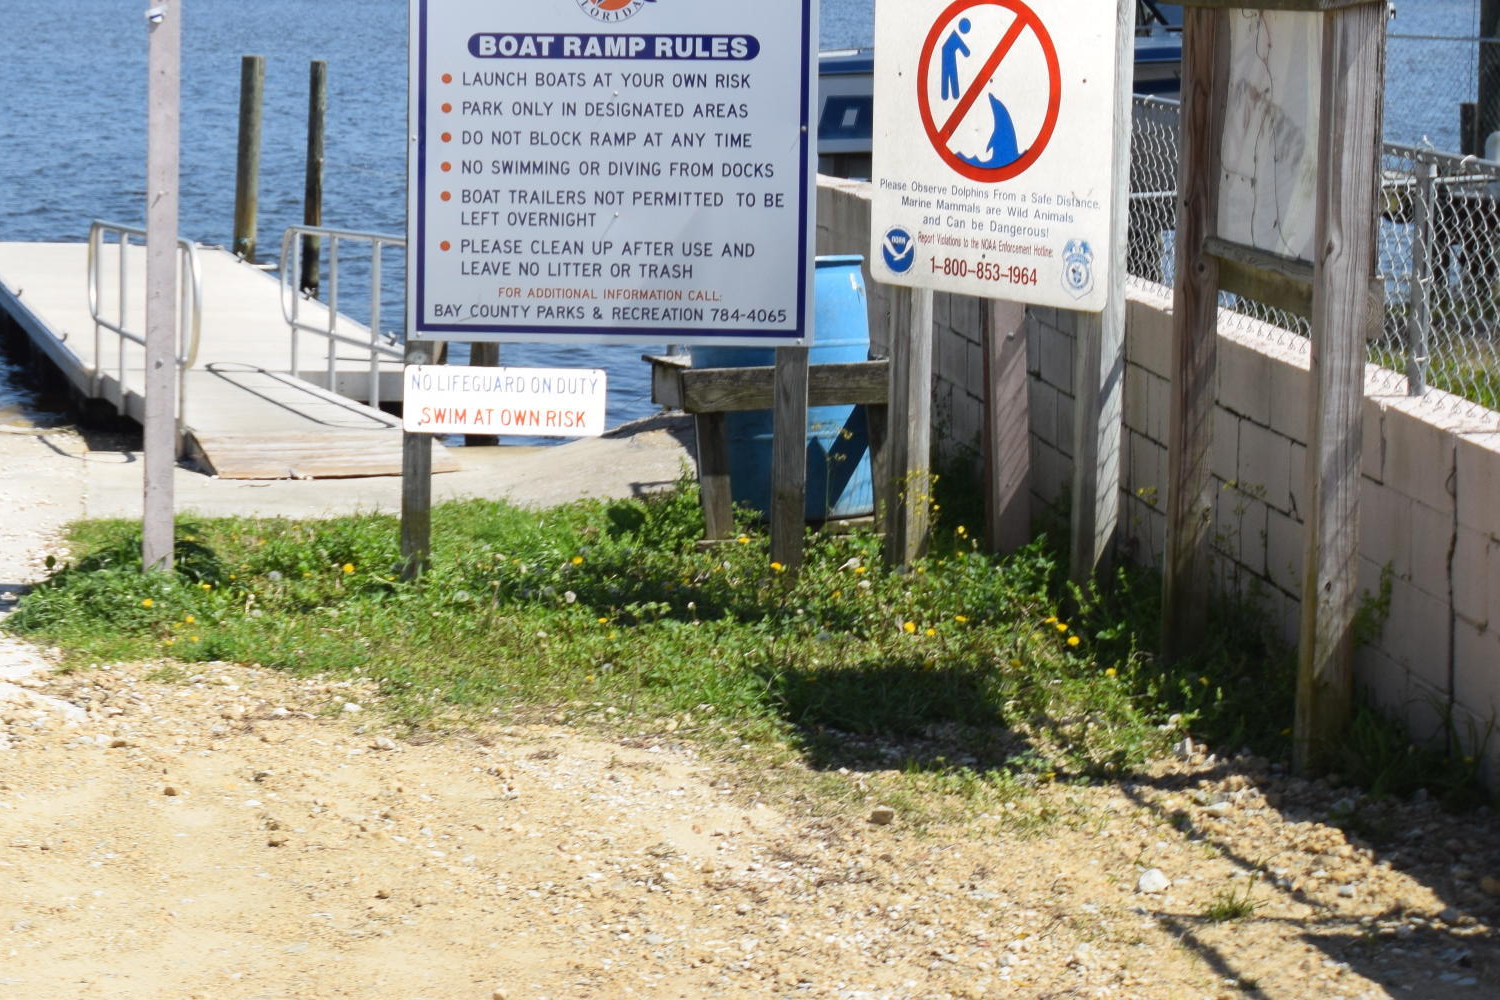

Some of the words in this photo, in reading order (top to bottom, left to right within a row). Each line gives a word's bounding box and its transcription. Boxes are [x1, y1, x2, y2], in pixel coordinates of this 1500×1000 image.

[478, 36, 555, 57] BOAT
[563, 37, 647, 58] RAMP
[654, 37, 748, 58] RULES
[462, 72, 527, 87] LAUNCH
[535, 73, 586, 88] BOATS
[593, 73, 612, 88] AT
[621, 74, 664, 88] YOUR
[672, 74, 707, 88] OWN
[715, 74, 751, 88] RISK
[462, 102, 502, 116] PARK
[512, 102, 553, 117] ONLY
[562, 103, 576, 117] IN
[585, 103, 684, 118] DESIGNATED
[693, 104, 748, 118] AREAS
[462, 131, 483, 145] DO
[491, 131, 521, 146] NOT
[530, 132, 581, 146] BLOCK
[590, 132, 637, 147] RAMP
[643, 133, 662, 147] AT
[671, 133, 706, 147] ANY
[715, 133, 752, 148] TIME
[461, 160, 483, 174] NO
[491, 160, 570, 175] SWIMMING
[579, 161, 600, 175] OR
[608, 162, 661, 176] DIVING
[670, 162, 713, 177] FROM
[722, 163, 774, 177] DOCKS
[461, 190, 500, 204] BOAT
[509, 190, 586, 205] TRAILERS
[594, 191, 624, 206] NOT
[632, 192, 724, 207] PERMITTED
[736, 193, 755, 207] TO
[764, 193, 785, 208] BE
[880, 178, 907, 191] Please
[911, 182, 947, 195] Observe
[951, 185, 989, 200] Dolphins
[993, 189, 1016, 201] From
[1020, 193, 1026, 202] a
[1031, 192, 1052, 204] Safe
[901, 196, 932, 209] Marine
[936, 200, 981, 213] Mammals
[986, 206, 1001, 215] are
[1007, 206, 1028, 218] Wild
[1034, 209, 1074, 223] Animals
[461, 212, 498, 226] LEFT
[507, 212, 597, 228] OVERNIGHT
[923, 214, 940, 226] and
[946, 216, 966, 229] Can
[971, 219, 984, 231] be
[989, 221, 1049, 238] Dangerous!
[460, 239, 523, 255] PLEASE
[530, 240, 584, 255] CLEAN
[591, 241, 613, 256] UP
[621, 242, 674, 256] AFTER
[682, 242, 713, 257] USE
[721, 243, 755, 258] AND
[917, 231, 935, 246] Report
[937, 233, 961, 248] Violations
[963, 237, 969, 248] to
[971, 237, 979, 249] the
[981, 237, 996, 250] NOAA
[999, 240, 1032, 255] Enforcement
[461, 261, 511, 276] LEAVE
[518, 262, 539, 276] NO
[547, 262, 601, 277] LITTER
[610, 263, 630, 278] OR
[639, 263, 693, 279] TRASH
[930, 255, 1037, 286] 1-800-853-1964
[498, 287, 522, 298] FOR
[527, 288, 598, 299] ADDITIONAL
[603, 289, 682, 301] INFORMATION
[434, 304, 463, 317] BAY
[469, 304, 530, 318] COUNTY
[538, 306, 585, 319] PARKS
[592, 307, 603, 320] &
[611, 307, 703, 321] RECREATION
[710, 309, 787, 323] 784-4065
[411, 374, 432, 391] NO
[437, 376, 525, 393] LIFEGUARD
[531, 377, 553, 394] ON
[557, 378, 598, 394] DUTY
[421, 407, 467, 425] SWIM
[474, 409, 495, 426] AT
[500, 409, 540, 427] OWN
[546, 410, 586, 428] RISK
